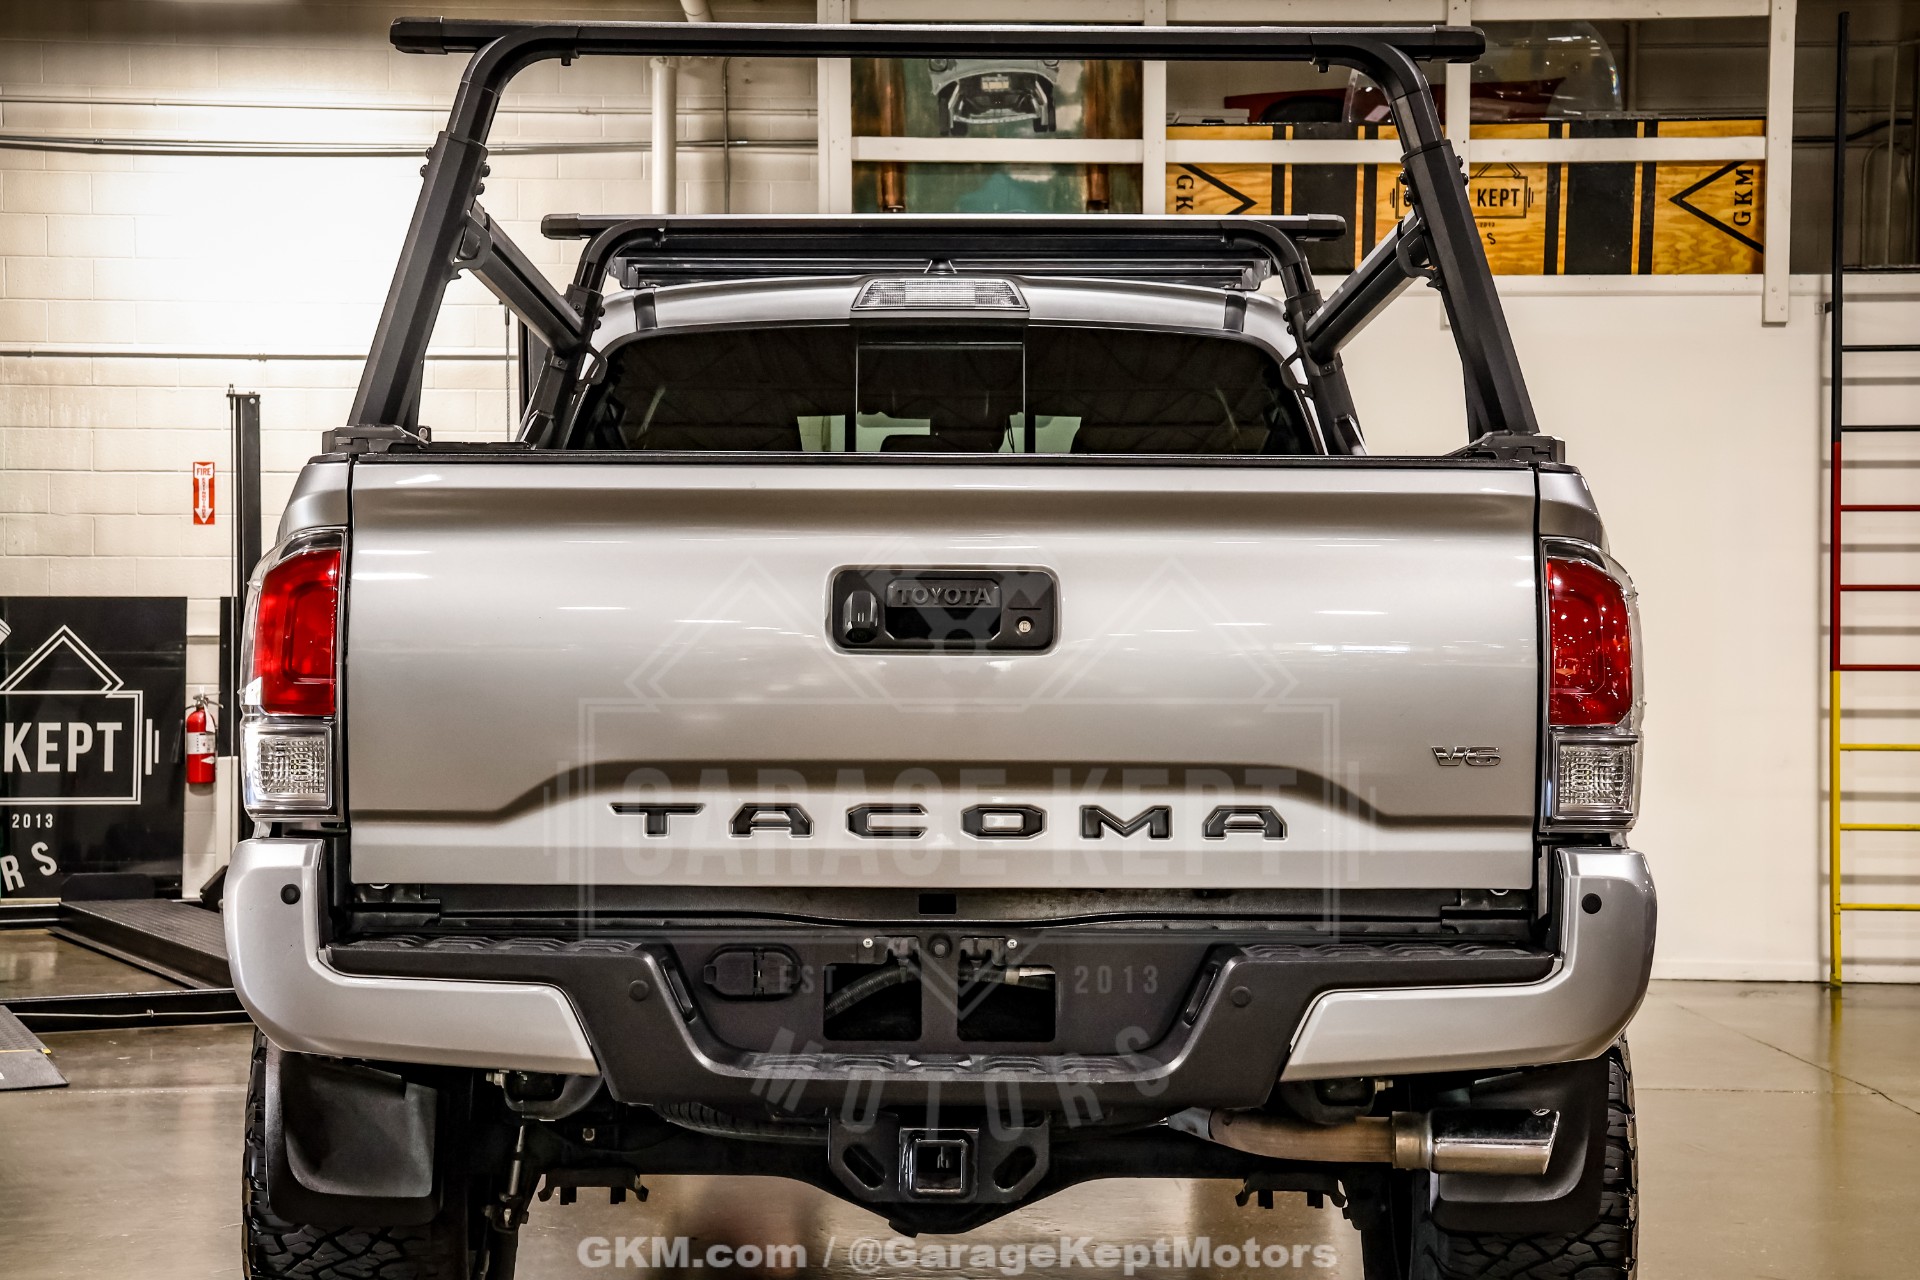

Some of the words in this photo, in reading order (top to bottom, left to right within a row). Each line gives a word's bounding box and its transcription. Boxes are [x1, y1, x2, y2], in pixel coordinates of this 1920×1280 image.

[1175, 174, 1194, 212] GK
[1477, 188, 1520, 207] KEPT
[1732, 168, 1754, 227] GKM
[196, 467, 211, 476] FIRE
[896, 587, 992, 606] TOYOTA
[3, 722, 123, 773] KEPT
[1431, 745, 1501, 767] V6
[11, 813, 54, 829] 2013
[608, 801, 1289, 842] TACOMA
